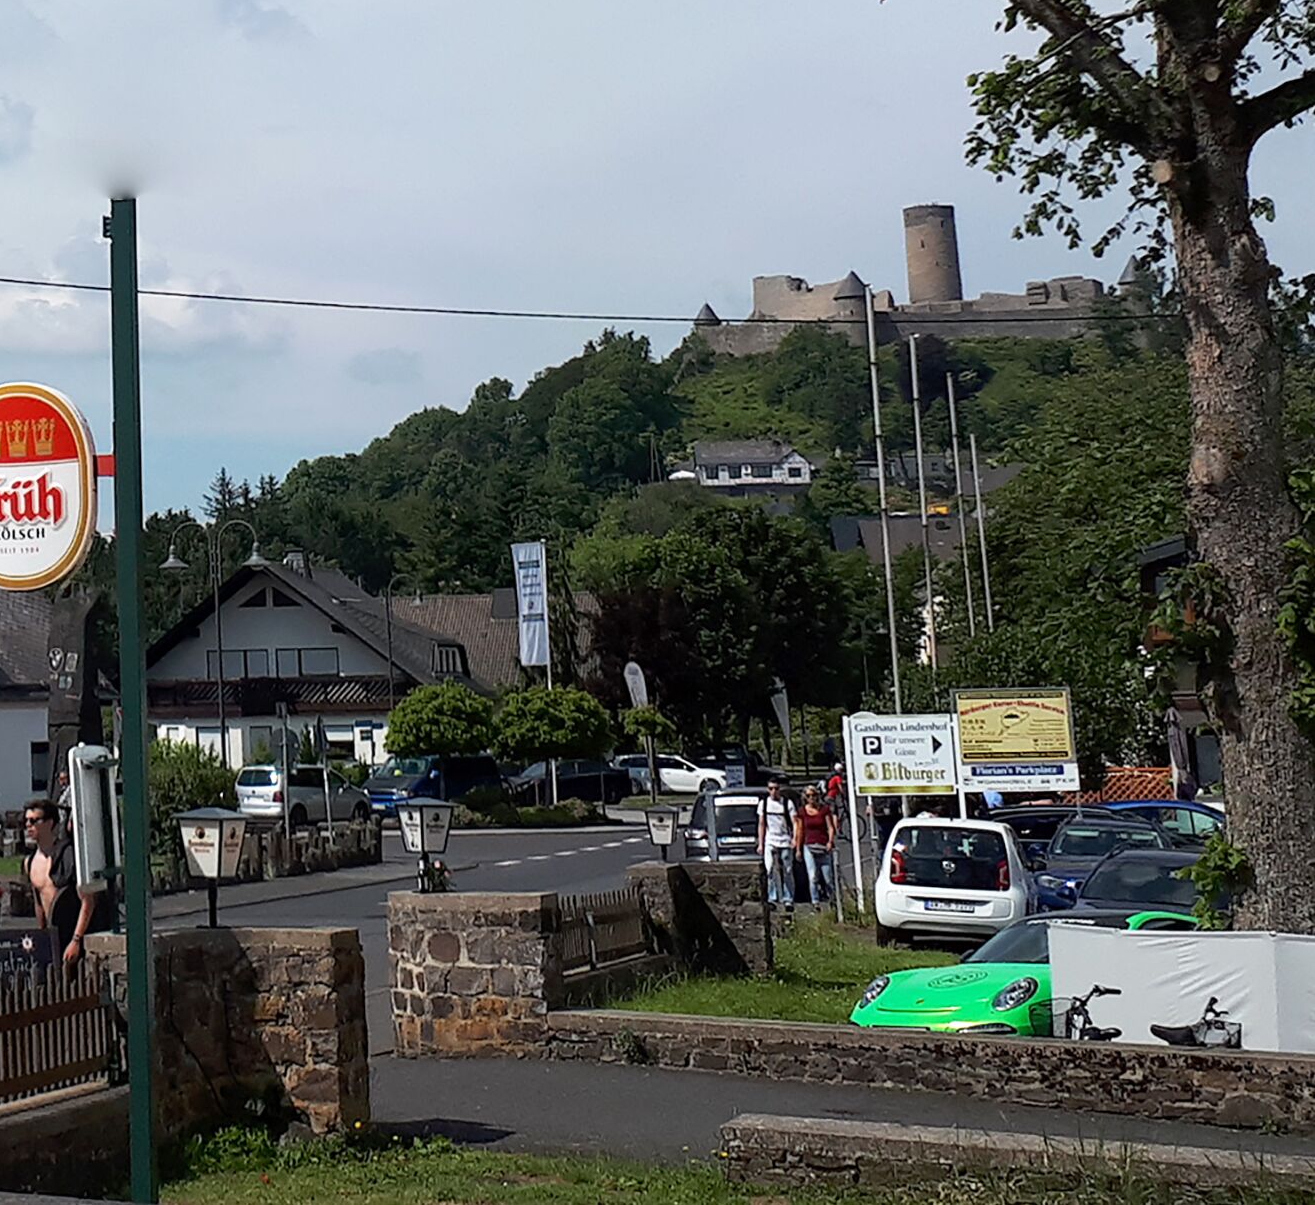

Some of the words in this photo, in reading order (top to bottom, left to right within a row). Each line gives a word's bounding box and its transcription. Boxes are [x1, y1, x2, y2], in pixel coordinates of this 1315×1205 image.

[854, 722, 898, 733] Gasthaus
[900, 722, 948, 731] Lindenhof
[864, 737, 880, 754] P
[881, 762, 946, 783] Bitburger
